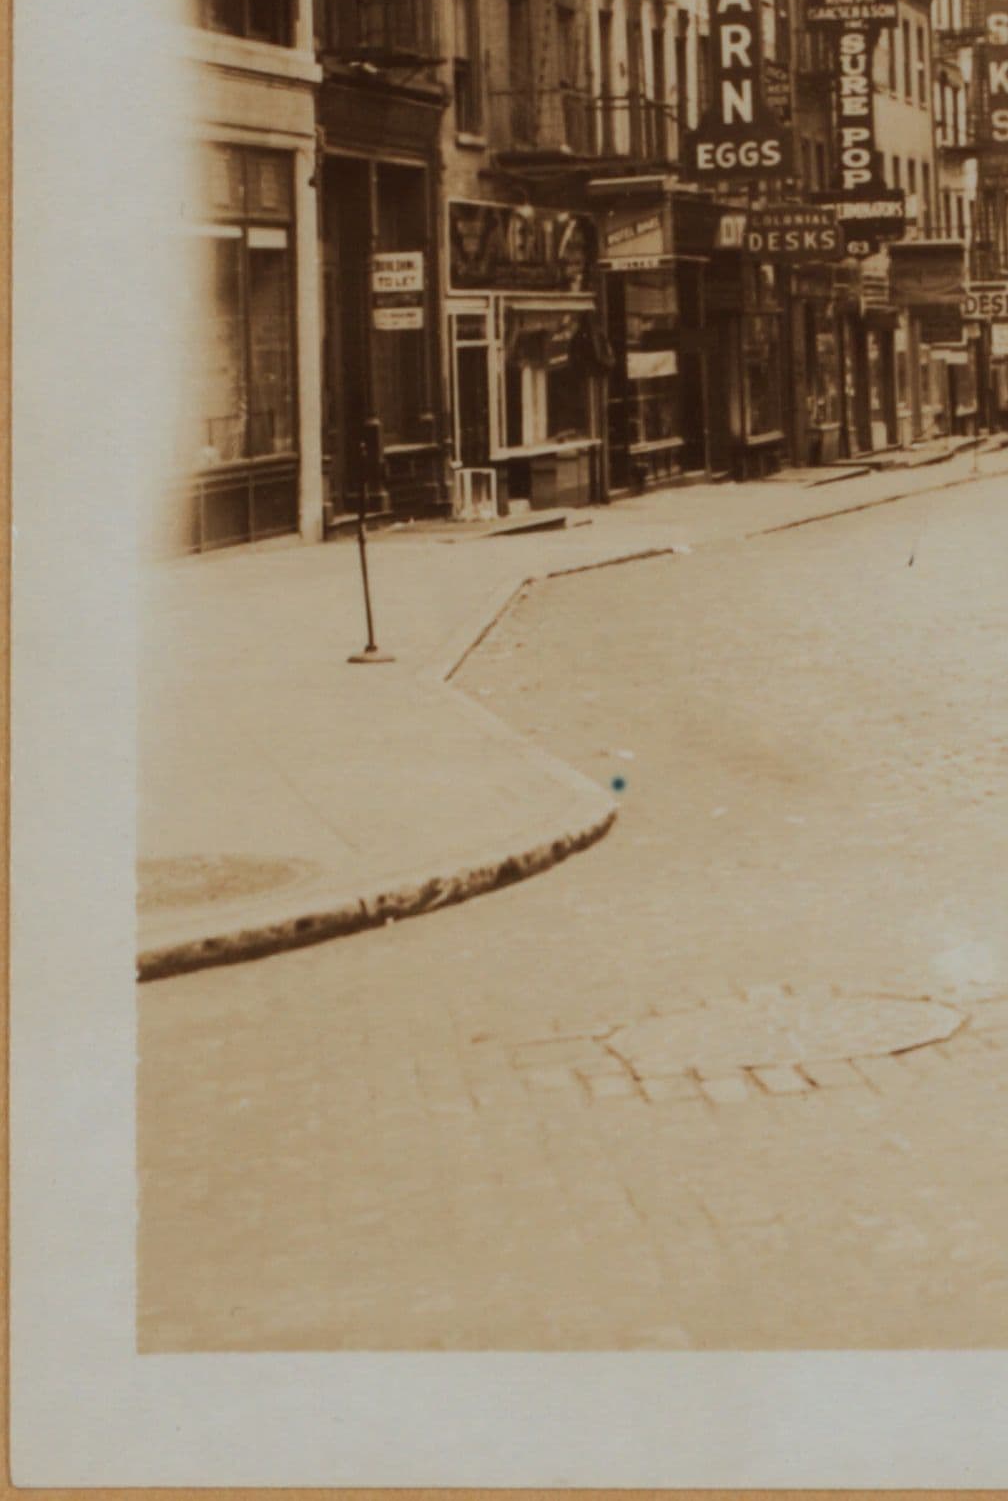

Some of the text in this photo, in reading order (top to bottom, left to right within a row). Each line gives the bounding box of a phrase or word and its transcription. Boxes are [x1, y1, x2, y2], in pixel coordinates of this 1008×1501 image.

[840, 34, 869, 117] SURE
[697, 140, 783, 170] EGGS
[841, 127, 872, 190] POP
[750, 230, 835, 251] DESKS
